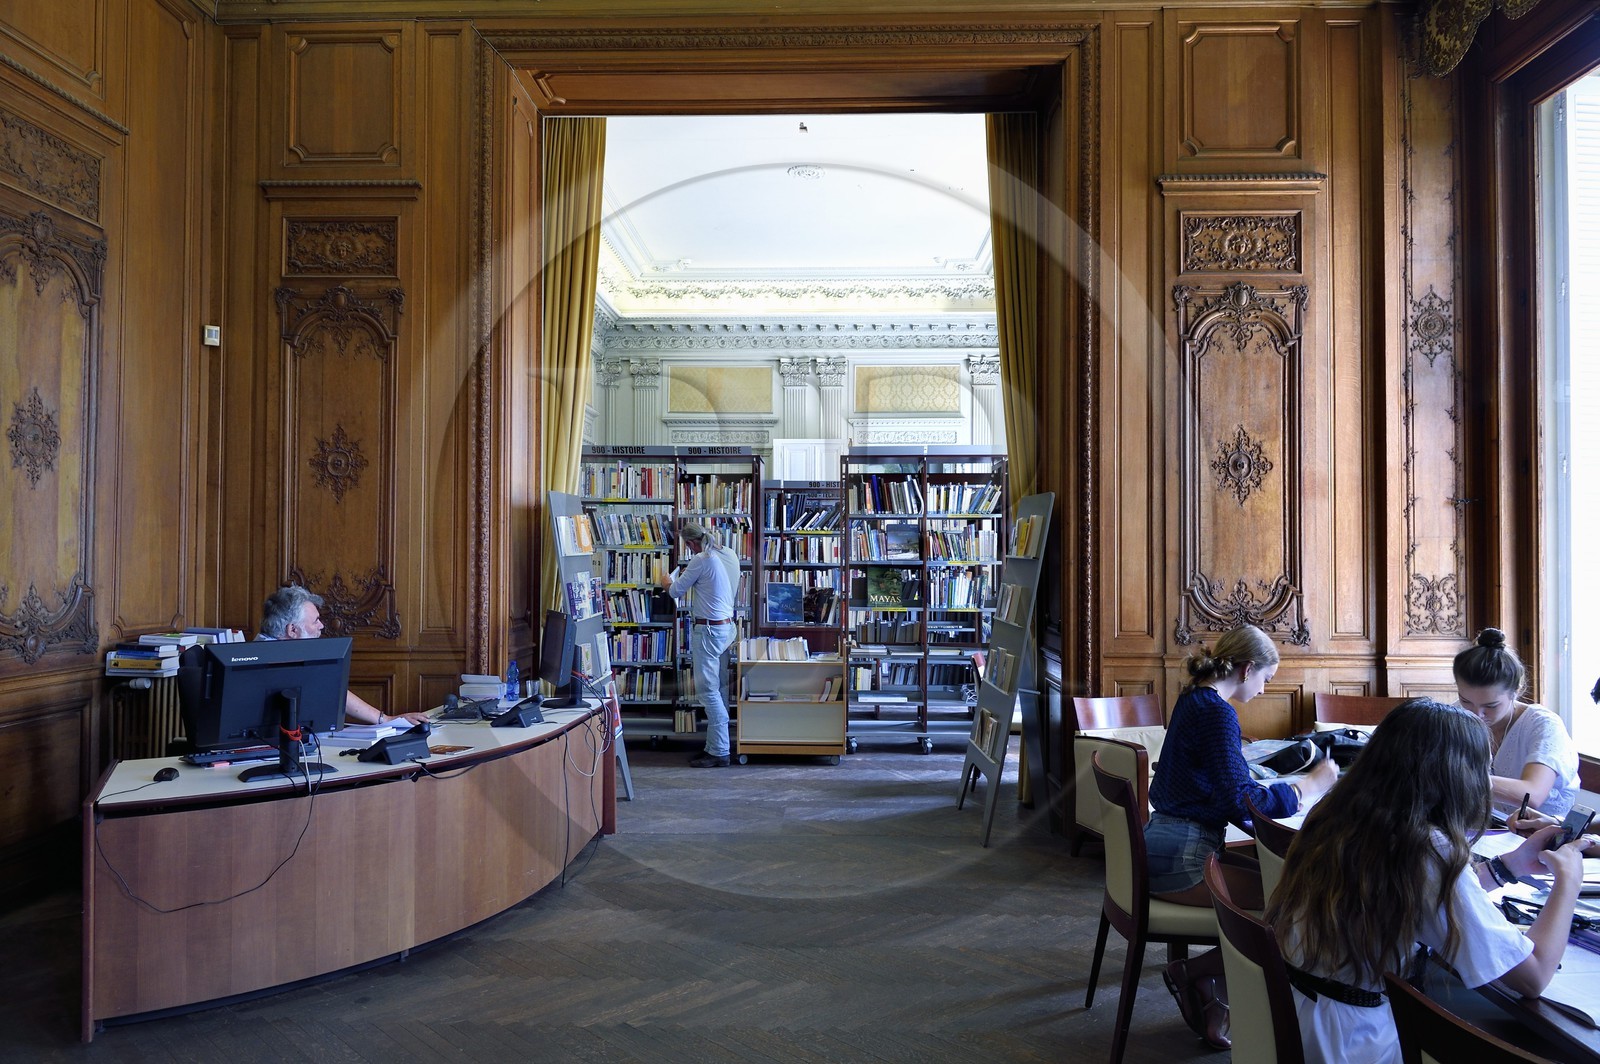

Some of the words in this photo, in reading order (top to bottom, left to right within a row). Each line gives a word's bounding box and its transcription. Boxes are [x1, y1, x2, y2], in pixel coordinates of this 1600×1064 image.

[591, 446, 606, 454] 900
[612, 446, 645, 454] HISTOIRE
[708, 446, 742, 454] HISTOIRE
[870, 595, 902, 603] MAYAS
